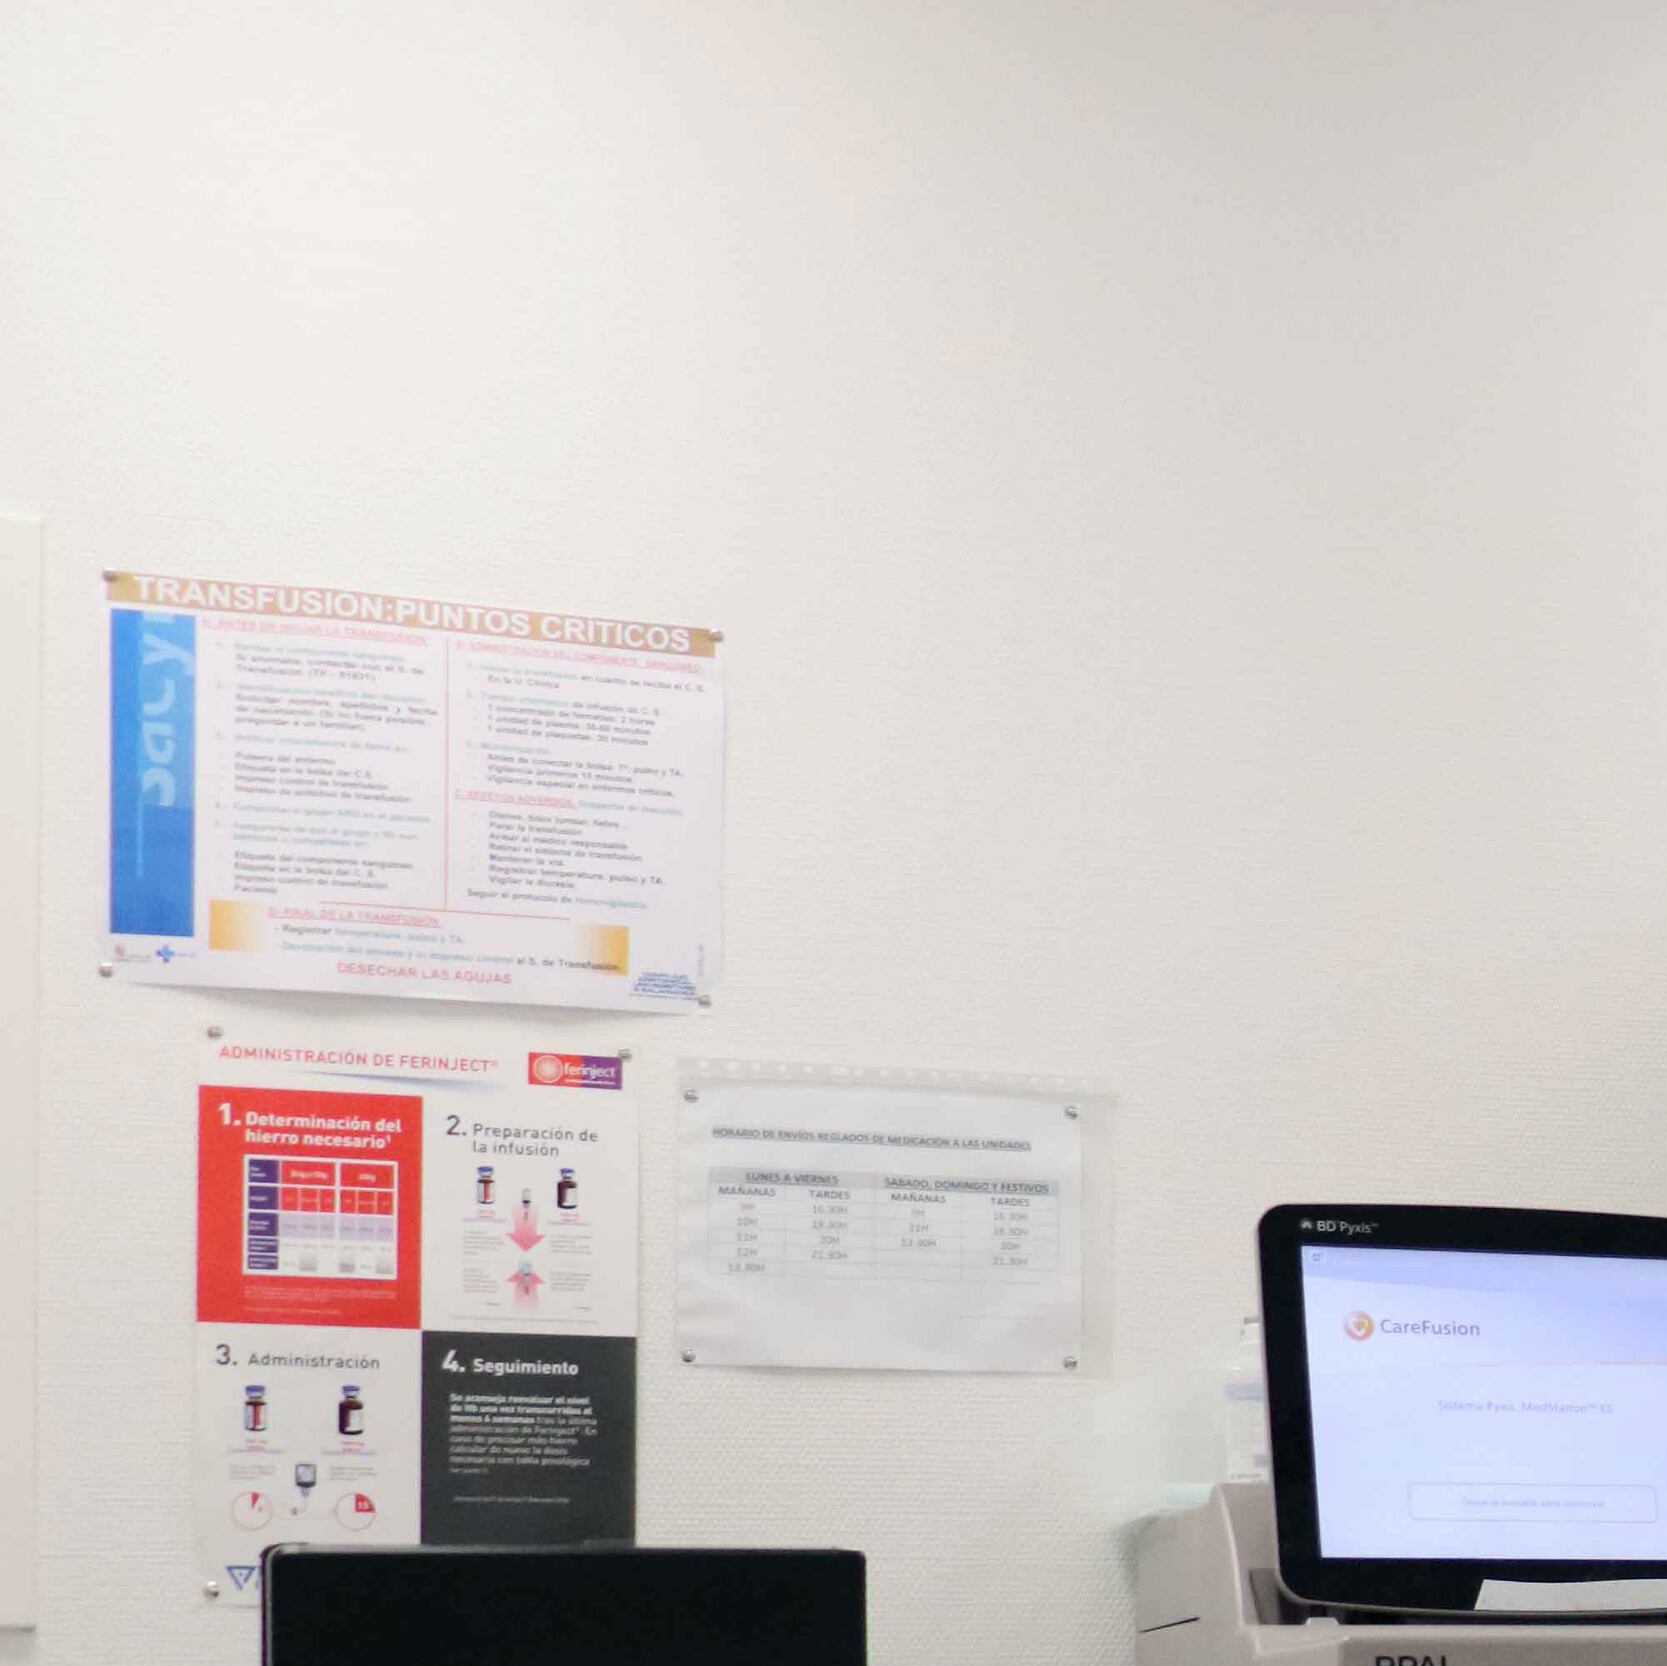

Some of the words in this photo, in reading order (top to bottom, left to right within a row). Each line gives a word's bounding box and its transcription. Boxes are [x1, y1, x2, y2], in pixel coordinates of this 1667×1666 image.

[337, 961, 417, 979] DESECHAR
[421, 967, 449, 980] LAS
[453, 968, 512, 985] AGUJAS
[219, 1045, 368, 1067] ADMINISTRACIÓN
[374, 1053, 393, 1067] DE
[563, 1061, 617, 1080] ferinject
[218, 1103, 241, 1127] 1.
[245, 1111, 370, 1132] Determinación
[375, 1117, 402, 1133] del
[244, 1128, 298, 1146] hierro
[446, 1115, 467, 1137] 2.
[472, 1122, 574, 1145] Preparación
[579, 1126, 598, 1142] de
[763, 1130, 775, 1139] DE
[953, 1138, 961, 1147] A
[472, 1140, 487, 1155] la
[492, 1141, 560, 1157] infusión
[809, 1190, 851, 1200] TARDES
[1316, 1220, 1336, 1232] BD
[1380, 1318, 1481, 1337] CareFusion
[216, 1343, 238, 1366] 3.
[247, 1351, 380, 1370] Administración
[441, 1349, 466, 1373] 4.
[473, 1357, 580, 1377] Seguimiento
